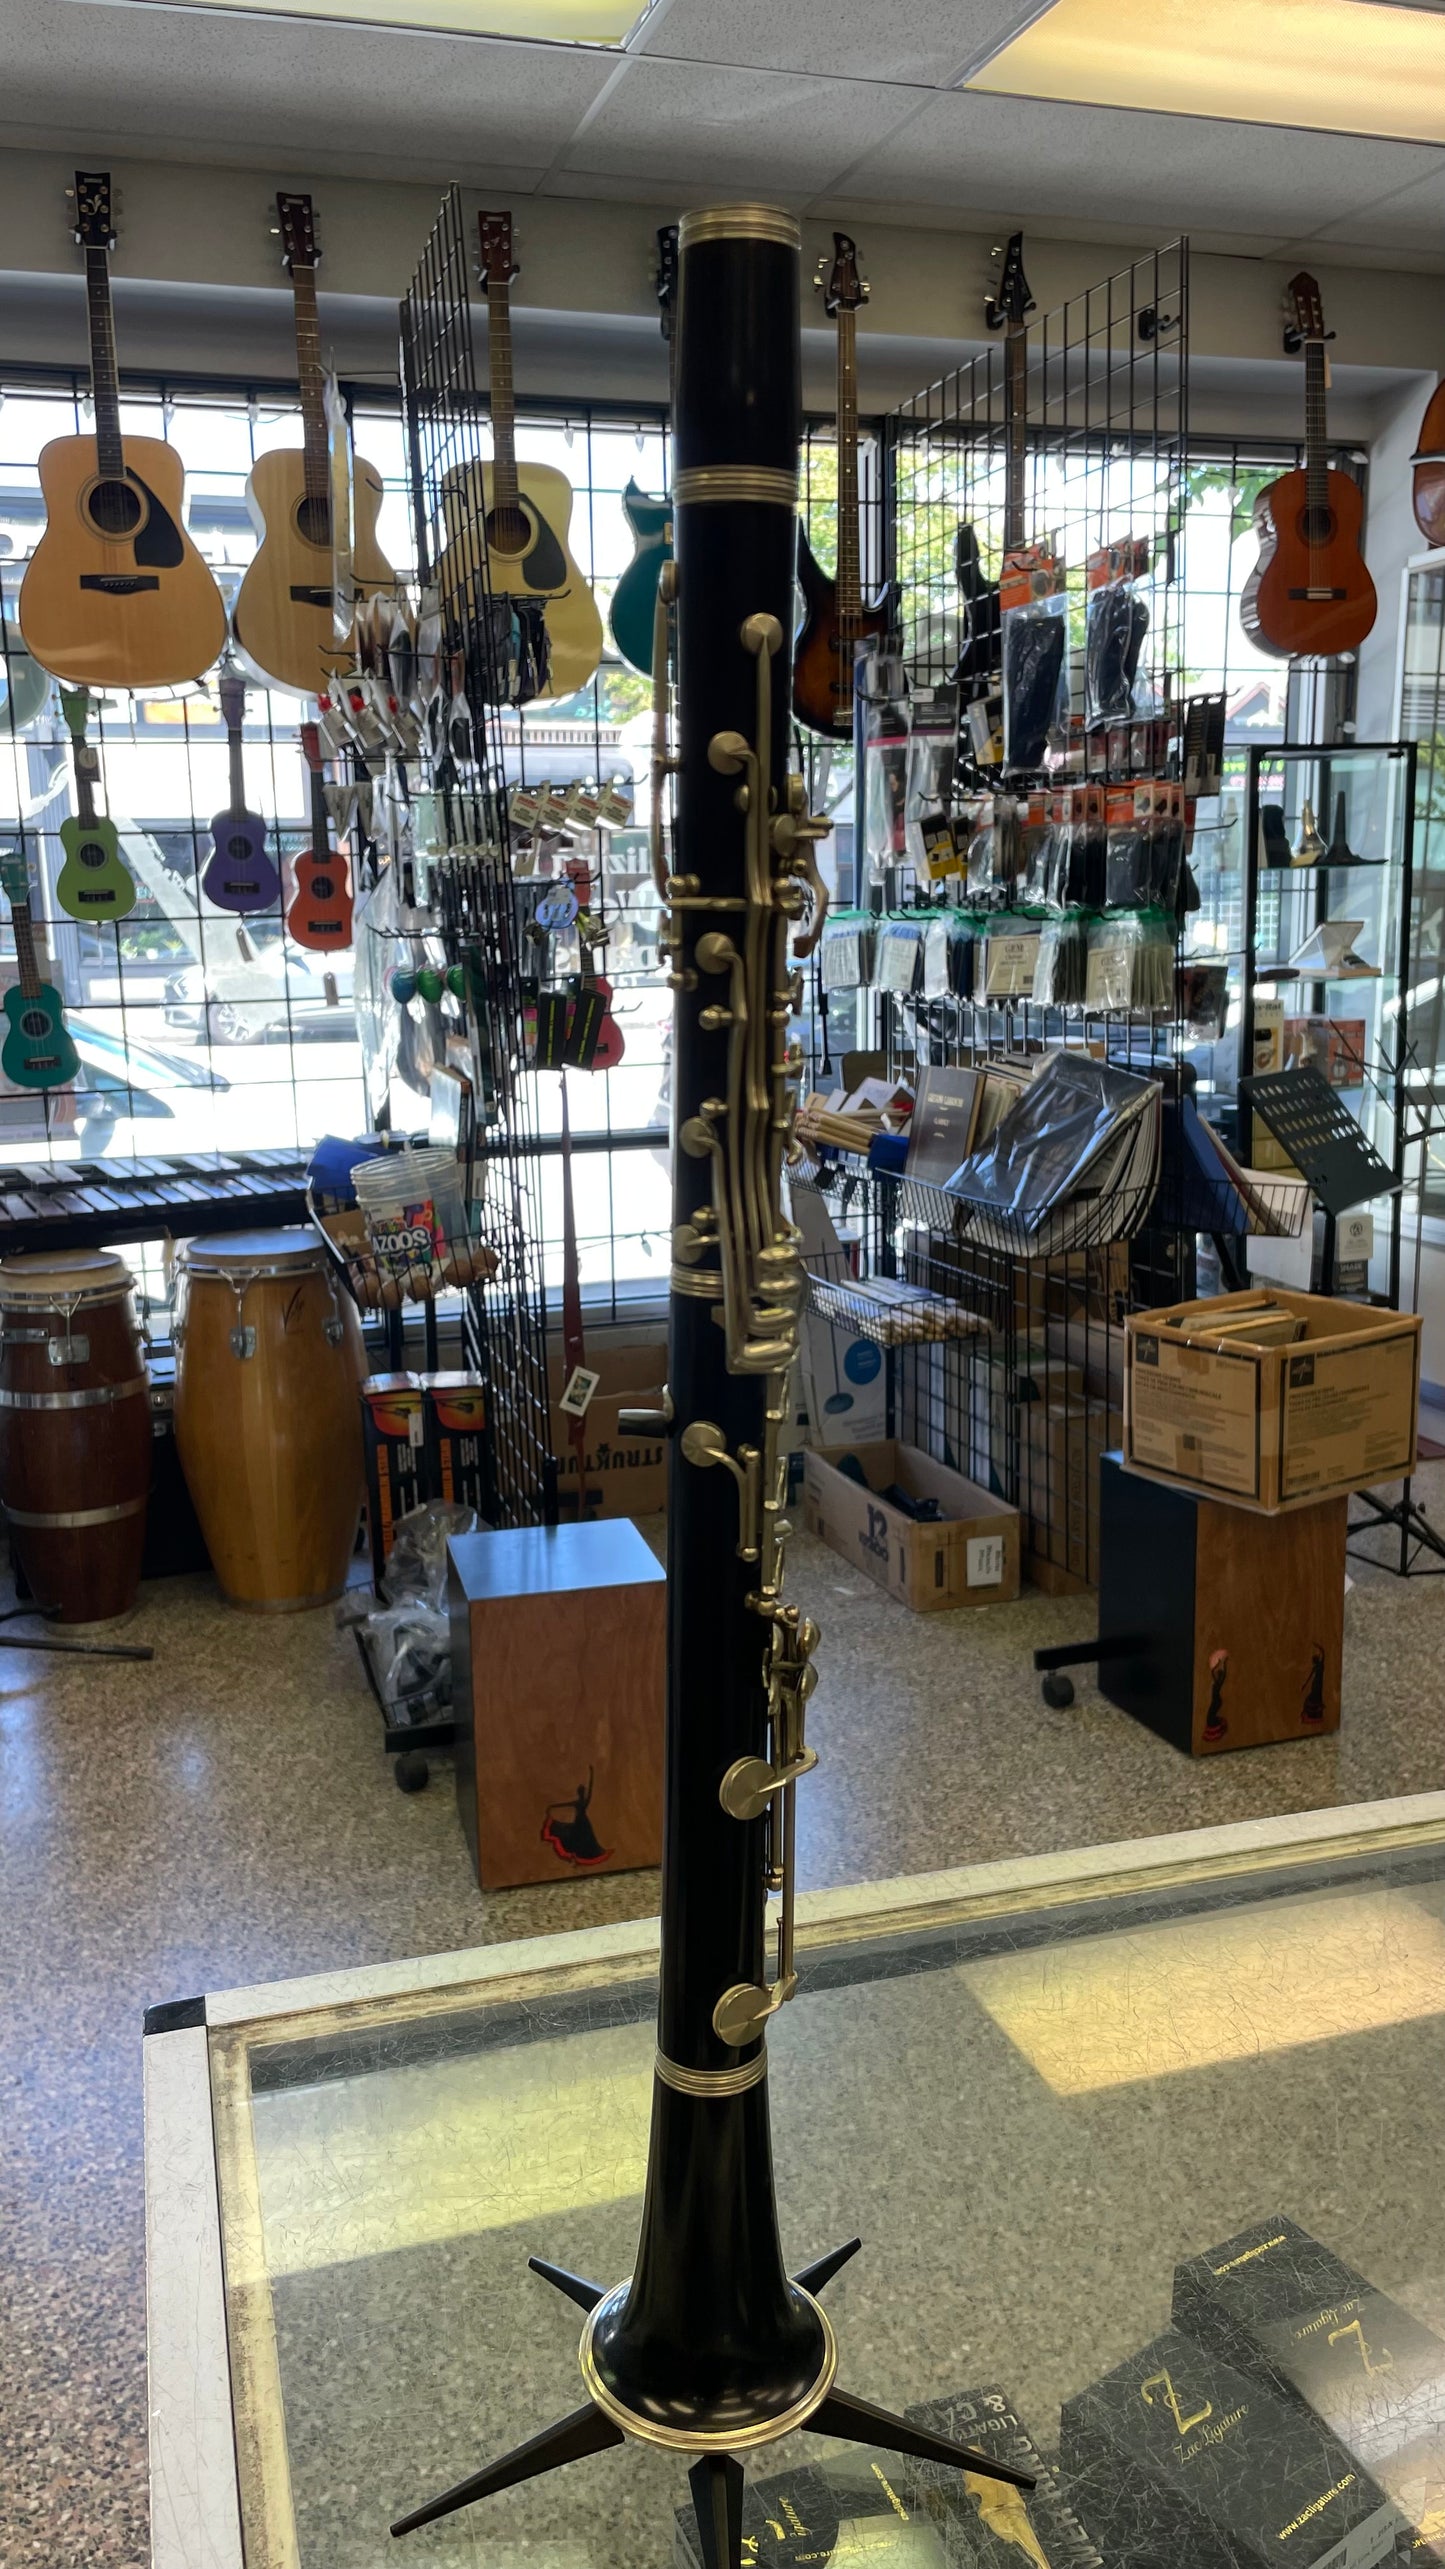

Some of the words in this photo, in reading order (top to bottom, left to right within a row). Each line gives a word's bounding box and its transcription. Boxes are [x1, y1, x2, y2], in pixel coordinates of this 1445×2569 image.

[372, 1229, 428, 1254] AZOOS
[1202, 2403, 1249, 2446] Ligature
[1275, 2473, 1356, 2541] www.zacligature.com
